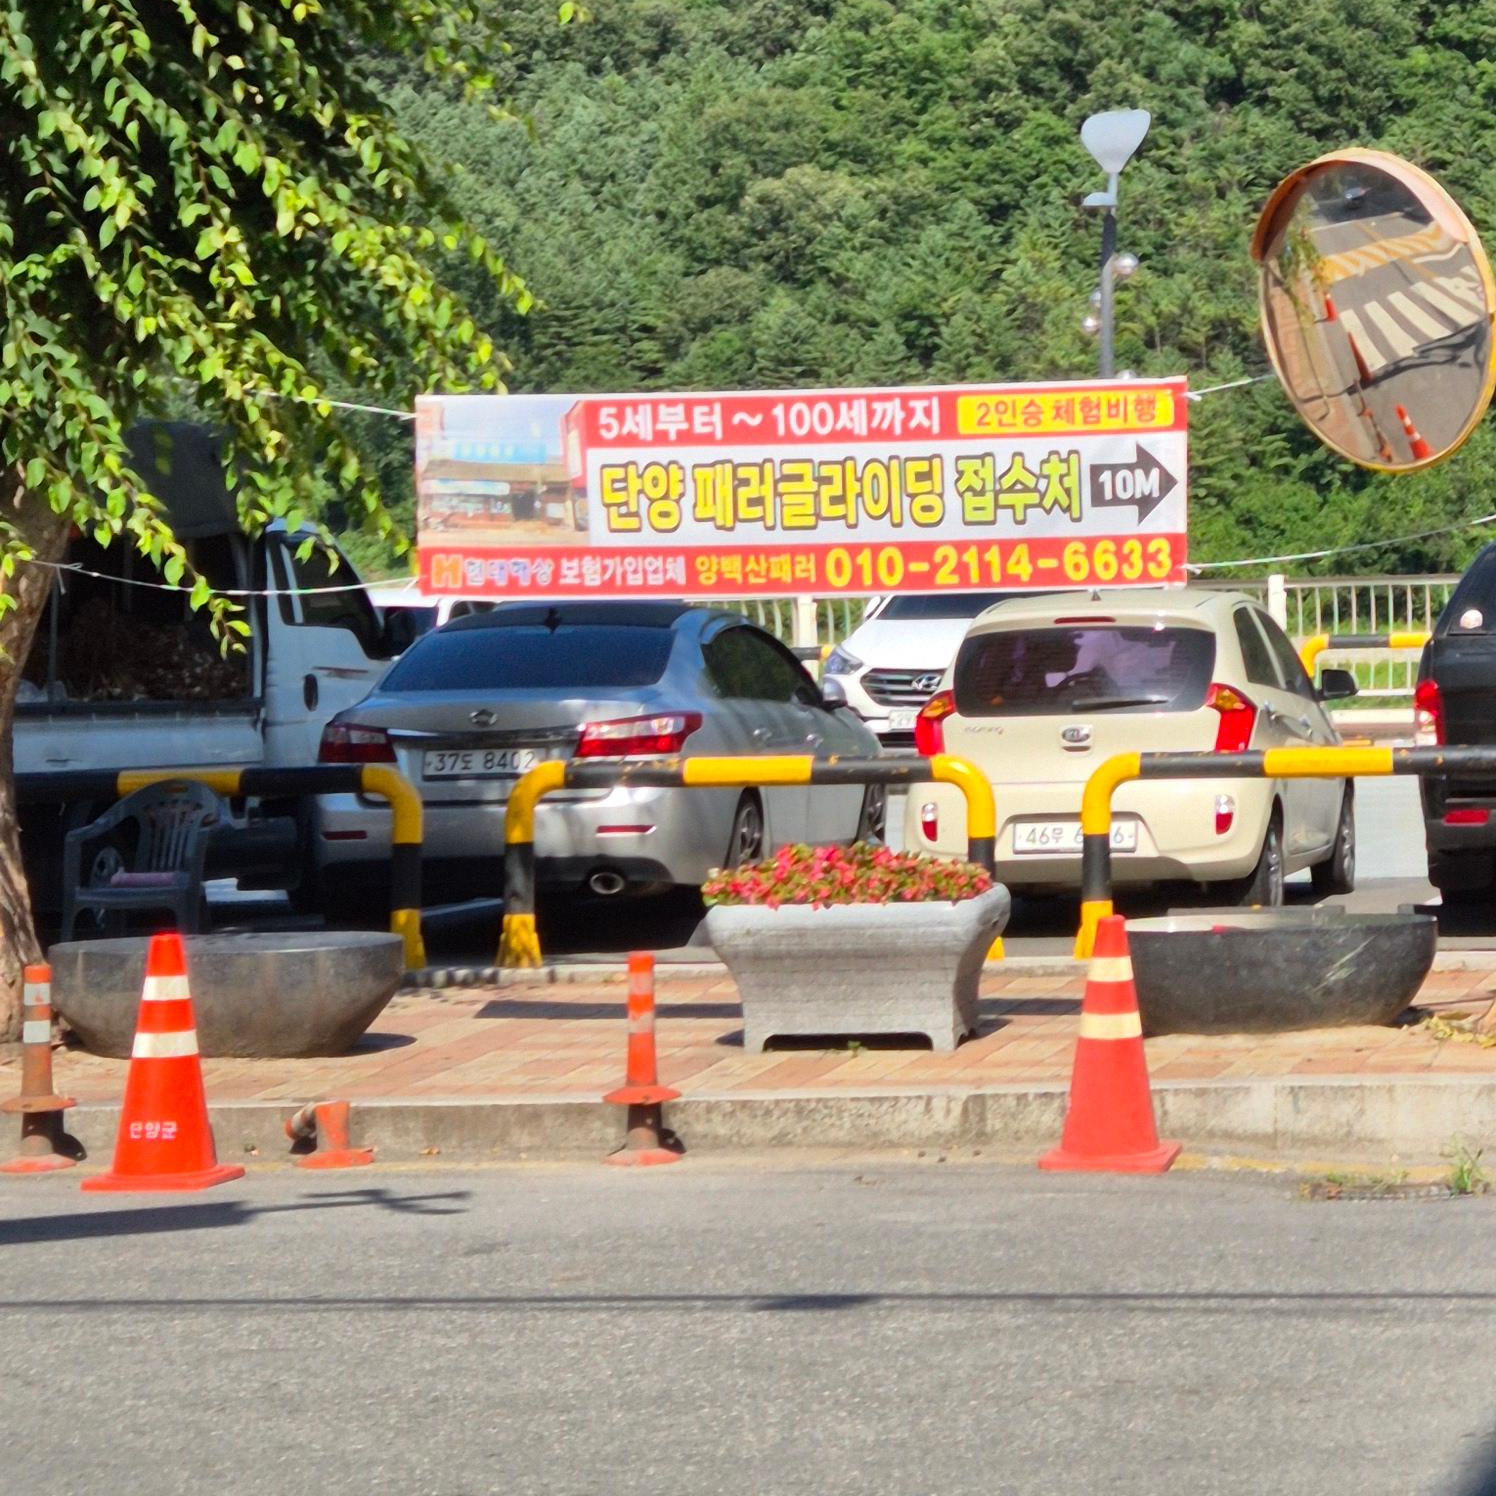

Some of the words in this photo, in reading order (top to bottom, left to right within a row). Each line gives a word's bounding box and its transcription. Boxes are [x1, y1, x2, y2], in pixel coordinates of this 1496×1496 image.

[976, 398, 1045, 427] 2인승
[1052, 393, 1157, 426] 체험비행
[600, 459, 686, 534] 단양
[692, 454, 946, 531] 패러글라이딩
[955, 449, 1083, 527] 접수처
[1099, 467, 1160, 502] 10M
[559, 555, 686, 587] 보험가입업체
[695, 552, 817, 585] 양백산패러
[825, 537, 1172, 588] 010-2114-6633
